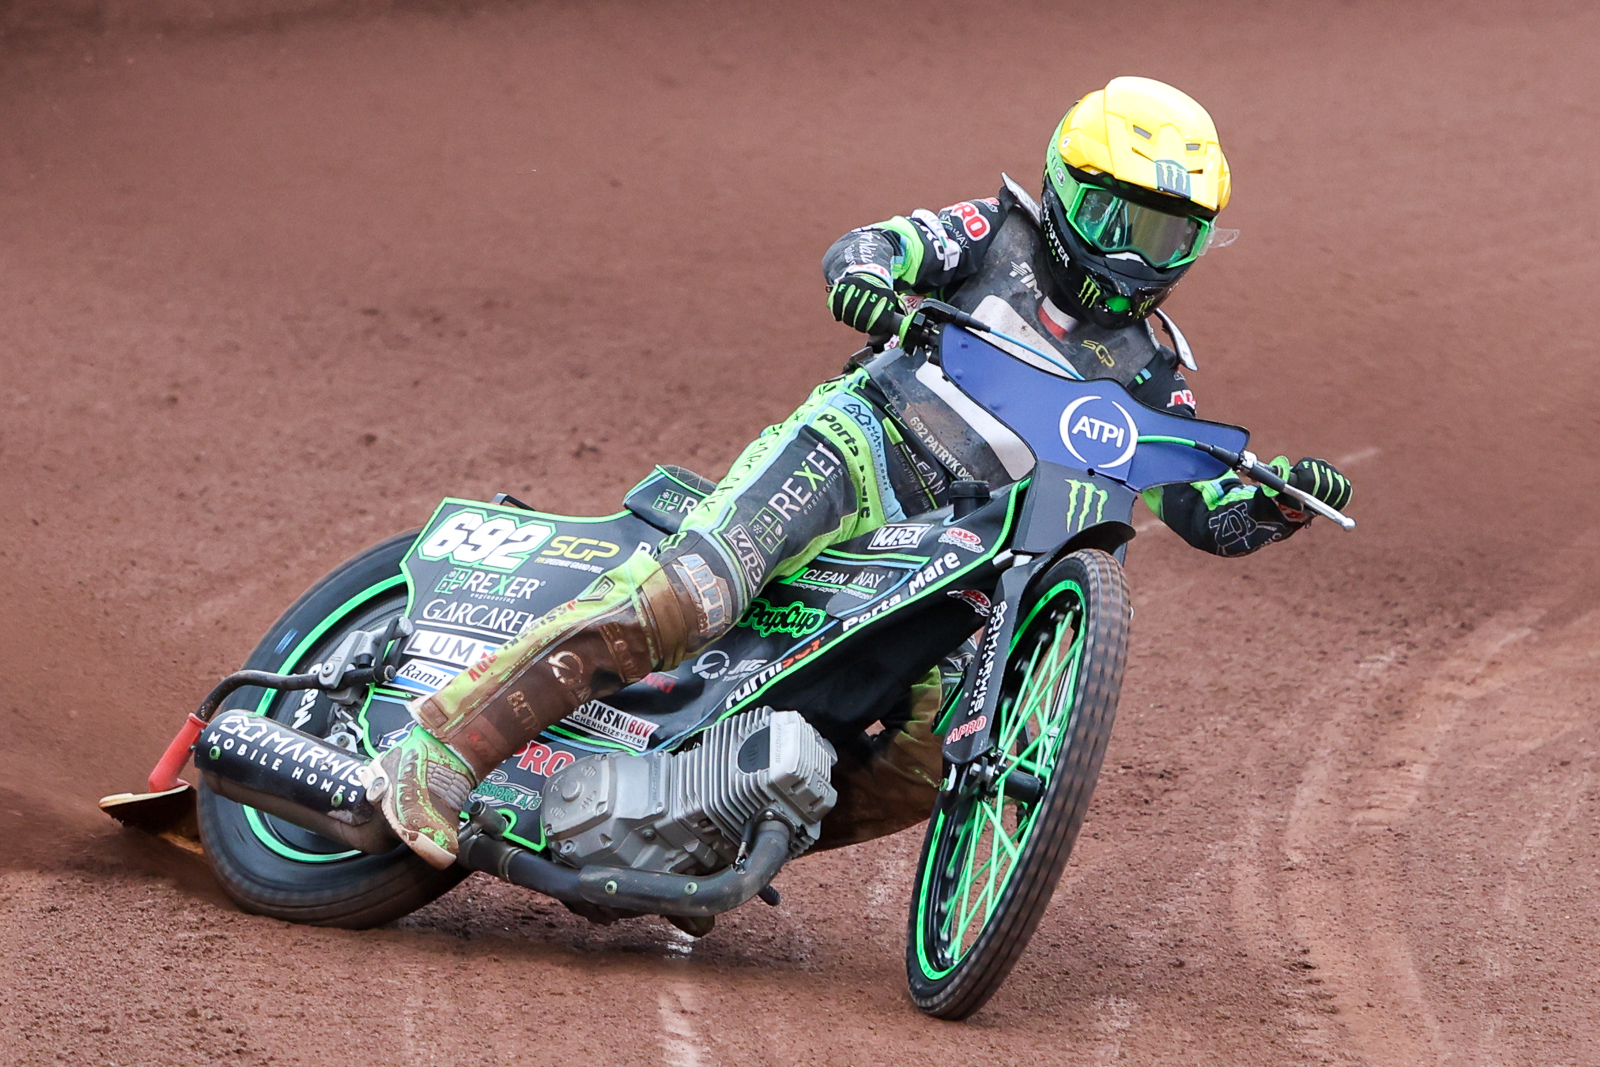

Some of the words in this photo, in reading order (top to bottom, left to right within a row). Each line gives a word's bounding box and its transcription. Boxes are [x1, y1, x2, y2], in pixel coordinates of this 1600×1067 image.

[909, 416, 929, 439] 692
[923, 434, 962, 473] PATRYK
[1071, 415, 1125, 448] ATPI
[422, 511, 552, 570] 692
[541, 536, 620, 561] SGP
[462, 570, 540, 600] REXER
[802, 568, 849, 585] CLEAN
[909, 551, 960, 596] Mare
[843, 593, 901, 632] Porta
[400, 663, 447, 687] Rami
[946, 715, 988, 745] APRO
[207, 731, 283, 772] MOBILE
[291, 766, 359, 803] HOMES
[259, 731, 369, 787] MARWIS
